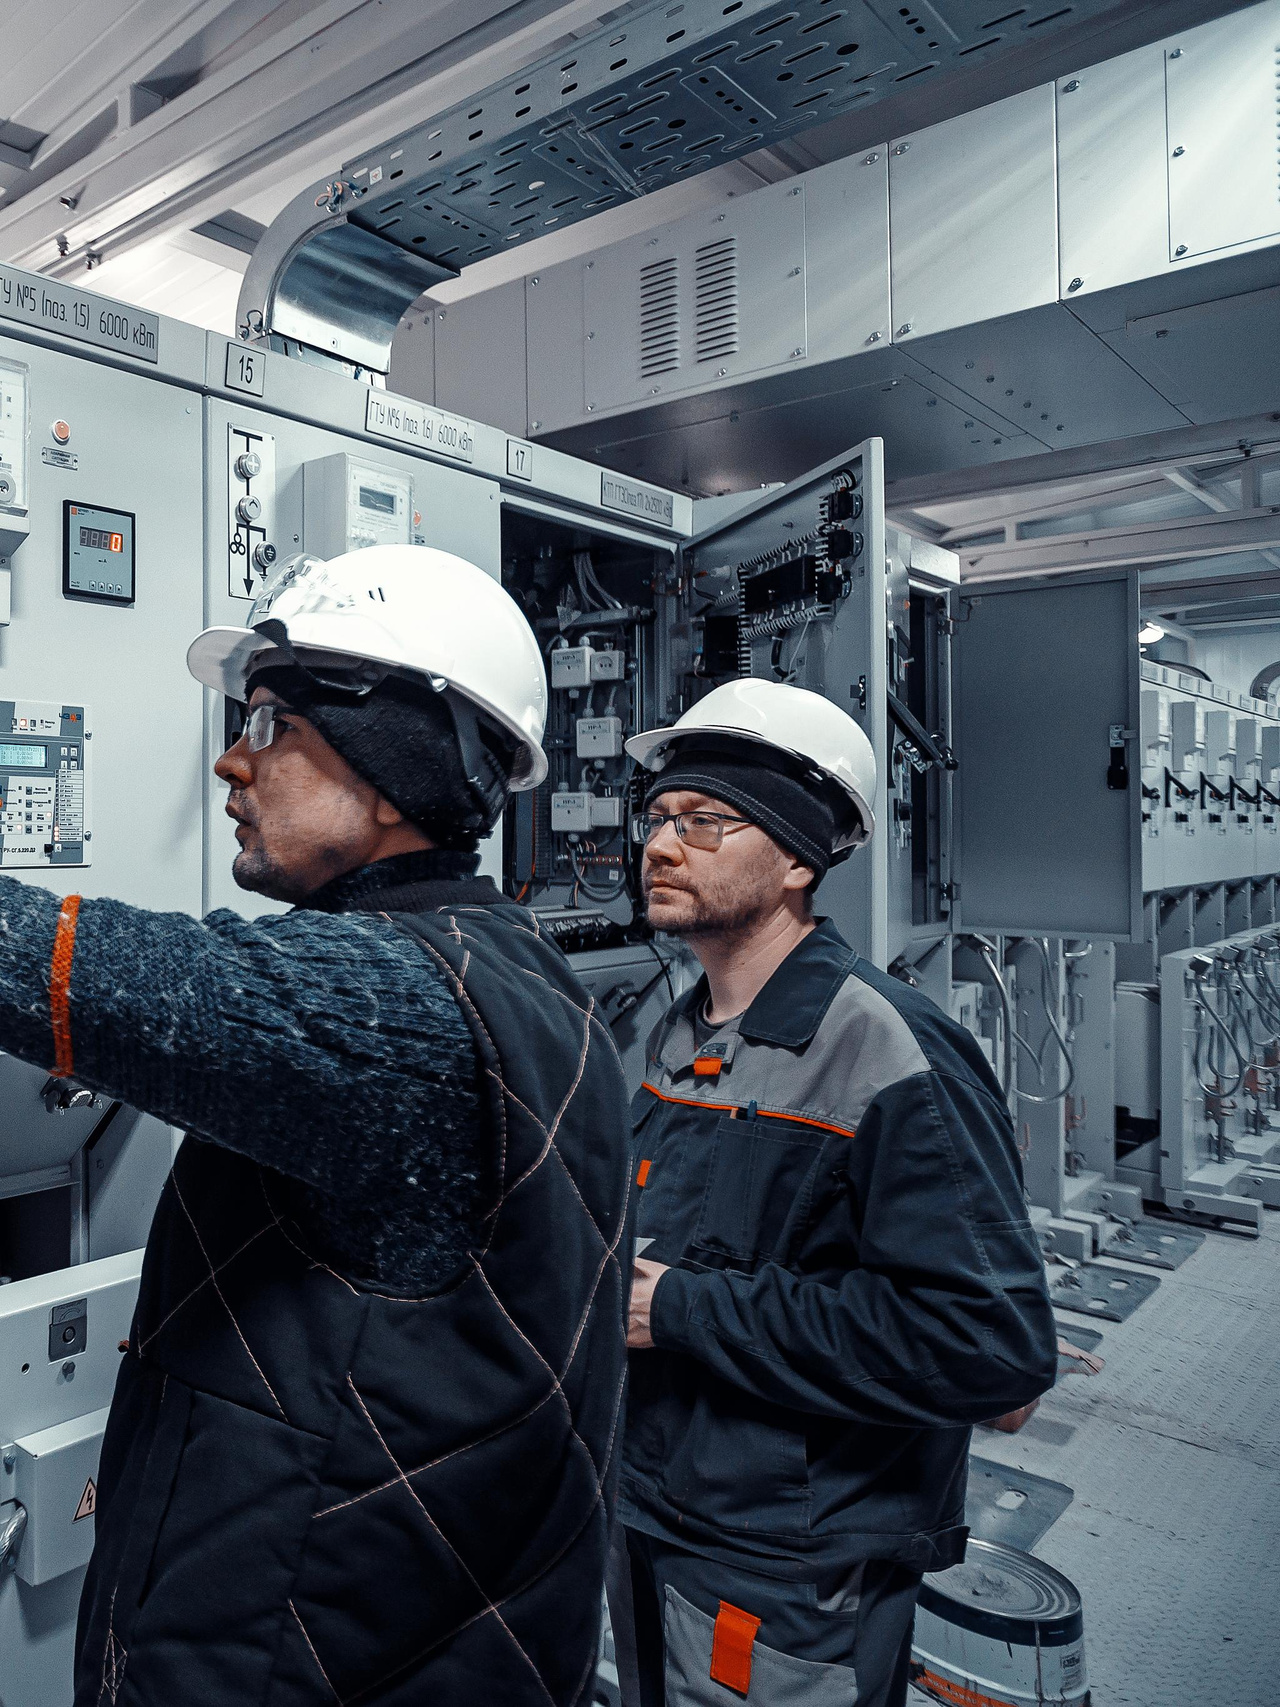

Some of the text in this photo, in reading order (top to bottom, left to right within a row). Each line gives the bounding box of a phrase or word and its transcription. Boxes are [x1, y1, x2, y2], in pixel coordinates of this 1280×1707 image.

[16, 282, 36, 312] №5
[41, 290, 68, 322] (поз.
[72, 302, 90, 330] 1.5)
[100, 311, 129, 341] 6000
[238, 354, 253, 383] 15
[369, 400, 385, 424] ГТУ
[387, 406, 400, 429] №6
[438, 424, 457, 447] 6000
[515, 449, 525, 471] 17
